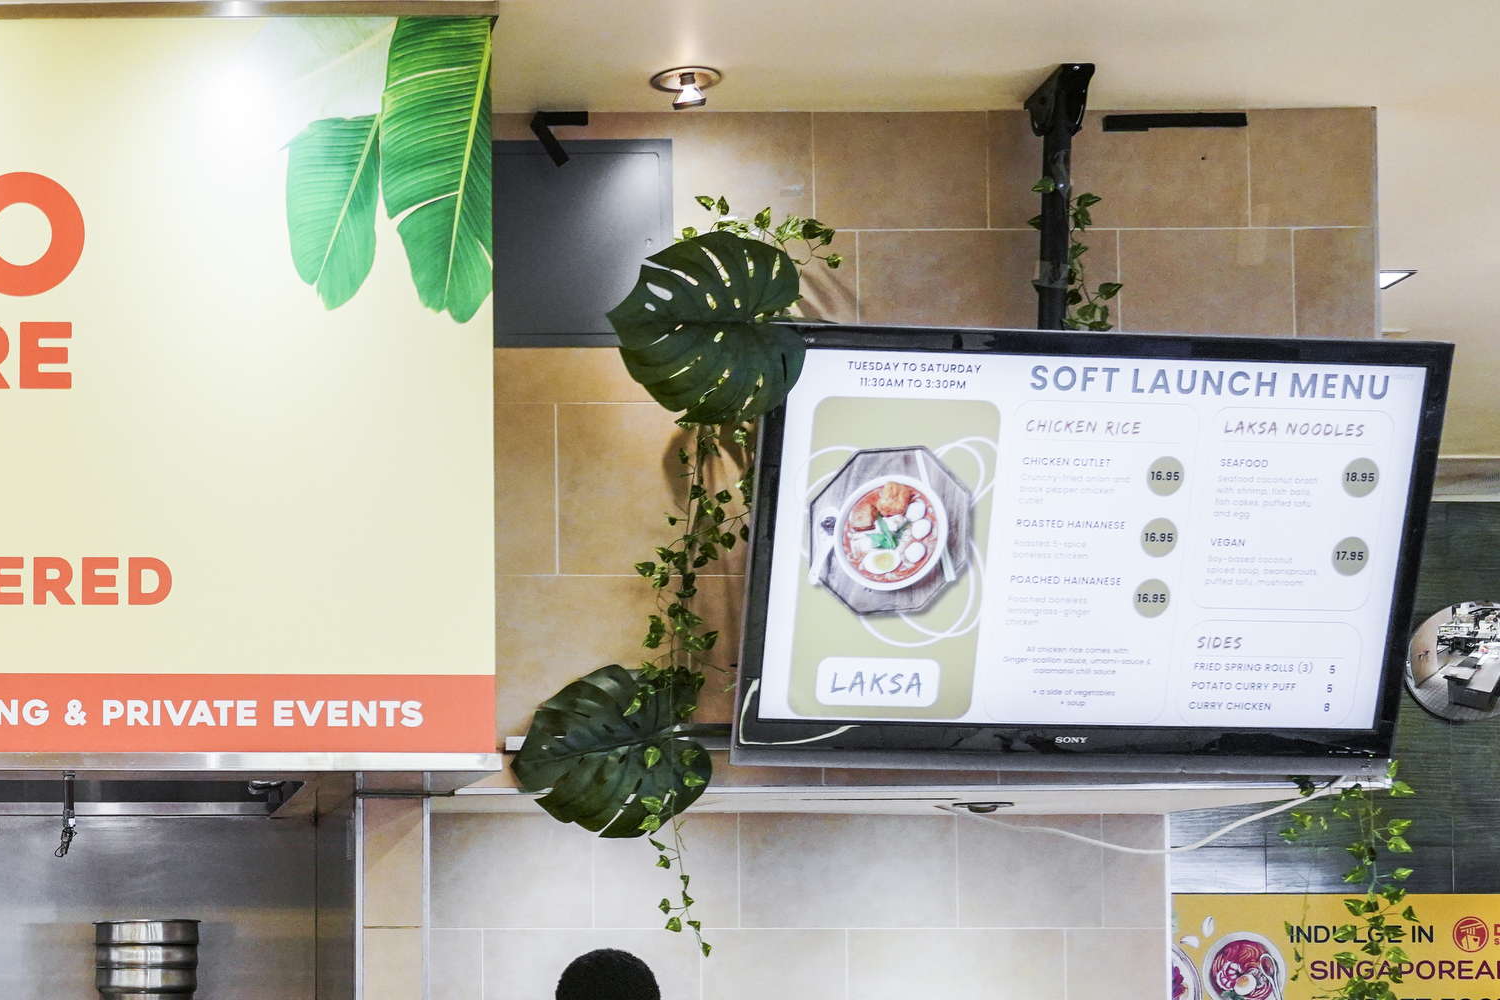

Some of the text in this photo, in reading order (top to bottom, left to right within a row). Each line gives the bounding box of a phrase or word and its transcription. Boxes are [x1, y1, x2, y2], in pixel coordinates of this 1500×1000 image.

[848, 361, 981, 373] TUESDAY TO SATURDAY
[860, 378, 966, 389] 11:30AM TO 3:30PM
[1030, 365, 1389, 400] SOFT LAUNCH MENU
[1026, 420, 1141, 436] CHICKEN RICE
[1224, 421, 1365, 437] LAKSA NOODLES
[1023, 457, 1111, 467] CHICKEN CUTLET
[1221, 459, 1269, 468] SEAFOOD
[1021, 474, 1130, 483] Crunchy-fried onion and
[1151, 471, 1179, 481] 16.95
[1218, 475, 1254, 483] Seafood
[1295, 477, 1318, 485] broth
[1346, 472, 1375, 482] 18.95
[1020, 485, 1114, 495] black pepper chicken
[1237, 487, 1268, 496] shrimp,
[1290, 488, 1312, 497] balls,
[1018, 497, 1043, 505] cutlet
[1215, 498, 1311, 509] fish cakes, puffed tofu
[1233, 511, 1250, 520] egg
[1016, 519, 1125, 530] ROASTED HAINANESE
[1145, 533, 1173, 542] 16.95
[1211, 538, 1245, 547] VEGAN
[1014, 540, 1086, 549] Roasted 5-spice
[1013, 551, 1088, 560] boneless chicken
[1208, 555, 1255, 565] Soy-based
[1336, 551, 1364, 561] 17.95
[1206, 566, 1235, 575] spiced
[1263, 567, 1319, 576] beansprouts,
[1010, 575, 1121, 586] POACHED HAINANESE
[1205, 578, 1233, 586] puffed
[1049, 596, 1087, 604] boneless
[1137, 593, 1166, 603] 16.95
[1006, 607, 1090, 617] lemongrass-ginger
[1005, 618, 1039, 626] chicken
[1197, 637, 1243, 650] SIDES
[1003, 656, 1061, 665] Ginger-scallion
[1090, 658, 1144, 666] umami-sauce
[1194, 661, 1336, 675] FRIED SPRING ROLLS (3) 5
[830, 671, 922, 698] LAKSA
[1191, 682, 1333, 693] POTATO CURRY PUFF 5
[1189, 702, 1330, 712] CURRY CHICKEN 8
[65, 700, 86, 725] &
[103, 700, 256, 726] PRIVATE
[274, 701, 423, 727] EVENTS
[1412, 925, 1433, 943] IN
